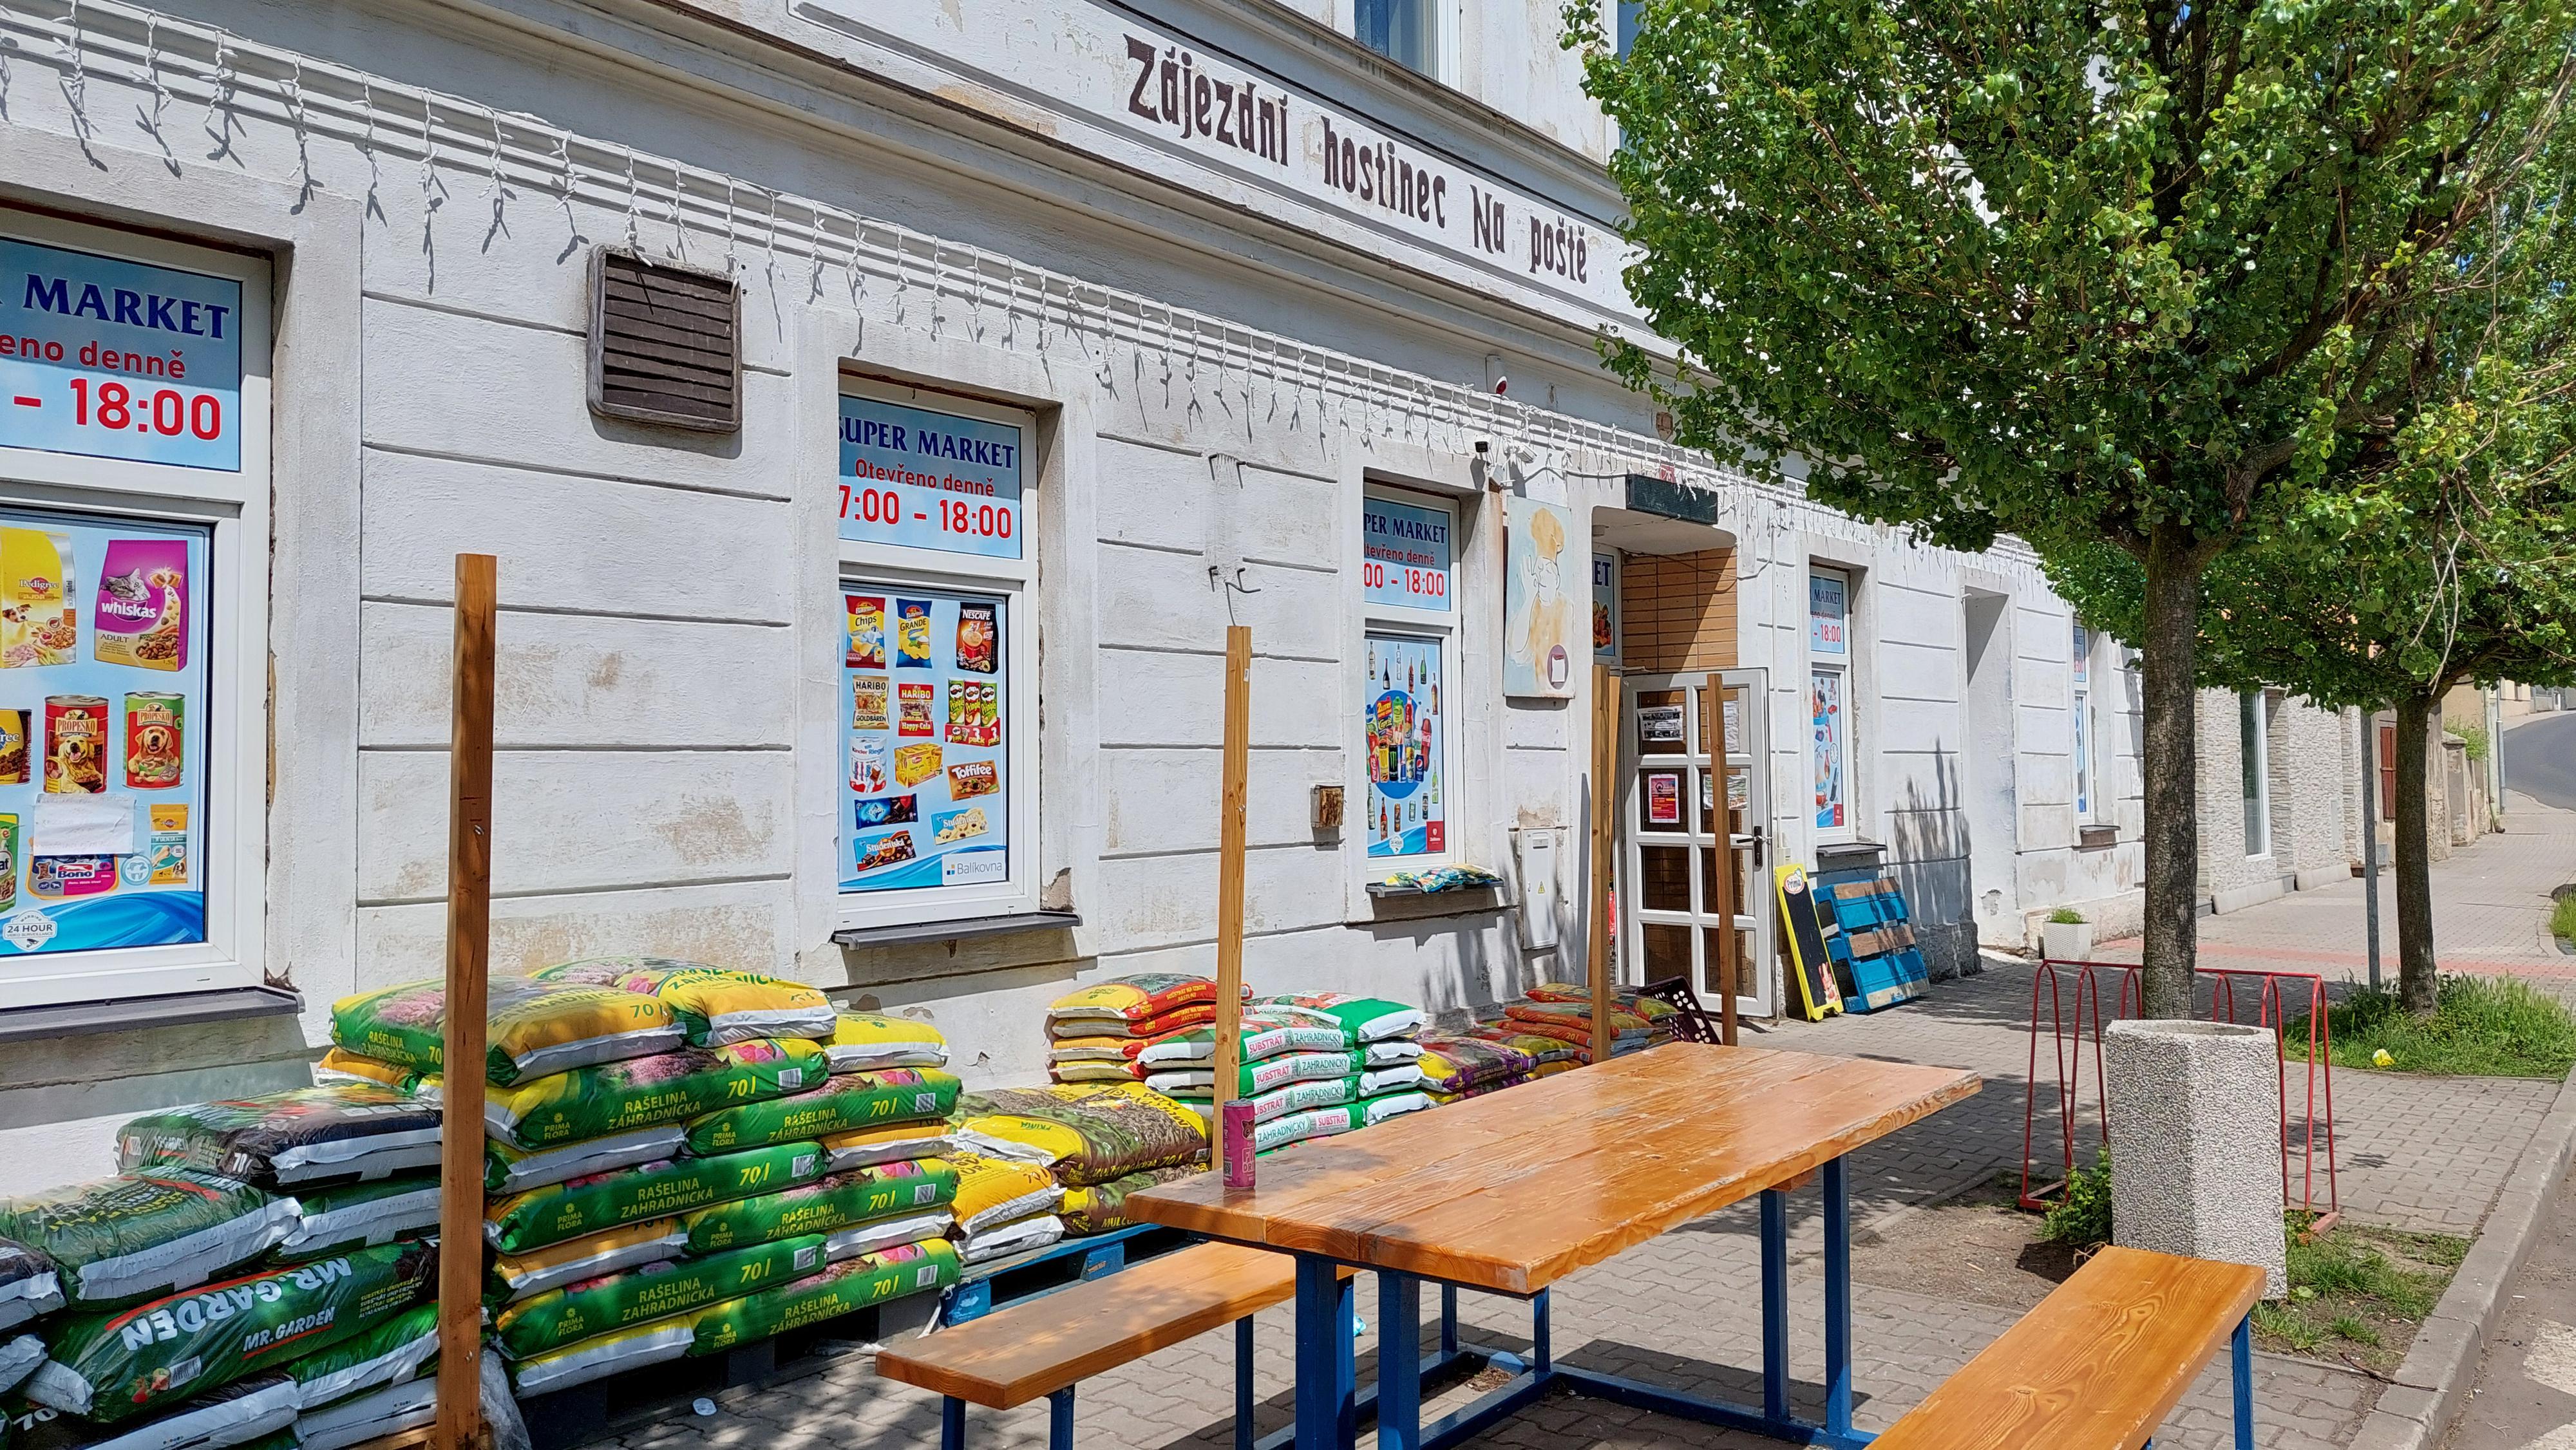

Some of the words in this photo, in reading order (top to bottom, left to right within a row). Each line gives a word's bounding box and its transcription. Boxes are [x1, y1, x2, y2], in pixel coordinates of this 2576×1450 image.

[1321, 116, 1446, 229] hostinec
[1470, 184, 1506, 254] Na
[1530, 216, 1588, 285] poště
[23, 273, 231, 339] MARKET
[79, 340, 187, 379] denně
[70, 377, 222, 442] 18:00
[917, 429, 1015, 469] MARKET
[855, 458, 937, 489] Otevřeno
[943, 473, 995, 497] denně
[838, 485, 900, 525] 7:00
[940, 499, 1012, 540] 18:00
[1392, 518, 1446, 544] MARKET
[1407, 549, 1435, 566] denně
[1593, 560, 1611, 587] ET
[19, 579, 59, 590] Pedigree
[1405, 568, 1445, 597] 18:00
[1814, 588, 1841, 605] MARKET
[101, 601, 157, 619] whiskas
[962, 609, 991, 620] NESCAFÉ
[855, 616, 877, 626] Chips
[900, 617, 927, 632] GRANDE
[100, 633, 129, 643] ADULT
[1821, 624, 1841, 643] 18:00
[856, 681, 886, 690] HARIBO
[902, 689, 931, 699] HARIBO
[140, 711, 171, 722] PROPESKO
[57, 720, 96, 733] PROPESKO
[952, 764, 992, 780] Toffifee
[57, 870, 93, 879] Bono
[957, 862, 1003, 874] Balíkovna
[22, 923, 53, 932] HOUR
[1249, 1033, 1283, 1054] SUBSTRÁT
[1256, 1064, 1290, 1084] SUBSTRÁT
[625, 1090, 688, 1115] RAŠELINA
[1255, 1097, 1284, 1116] UBSTRÁT
[784, 1107, 837, 1128] RAŠELINA
[544, 1121, 571, 1133] PRIMA
[544, 1129, 570, 1140] FLORA
[712, 1130, 737, 1141] PRIMA
[712, 1138, 735, 1147] FLORA
[637, 1176, 700, 1201] RAŠELINA
[620, 1185, 714, 1219] ZAHRADNICKÁ
[557, 1211, 583, 1223] PRIMA
[782, 1202, 836, 1225] RAŠELINA
[557, 1219, 583, 1232] FLORA
[710, 1229, 734, 1241] PRIMA
[710, 1236, 733, 1247] FLORA
[638, 1276, 701, 1303] RAŠELINA
[621, 1285, 715, 1322] ZAHRADNICKÁ
[784, 1293, 839, 1319] RAŠELINA
[121, 1281, 283, 1351] GARDEN
[274, 1306, 336, 1341] GARDEN
[558, 1315, 585, 1330] PRIMA
[558, 1323, 584, 1337] FLORA
[713, 1330, 737, 1342] PRIMA
[712, 1337, 735, 1349] FLORA
